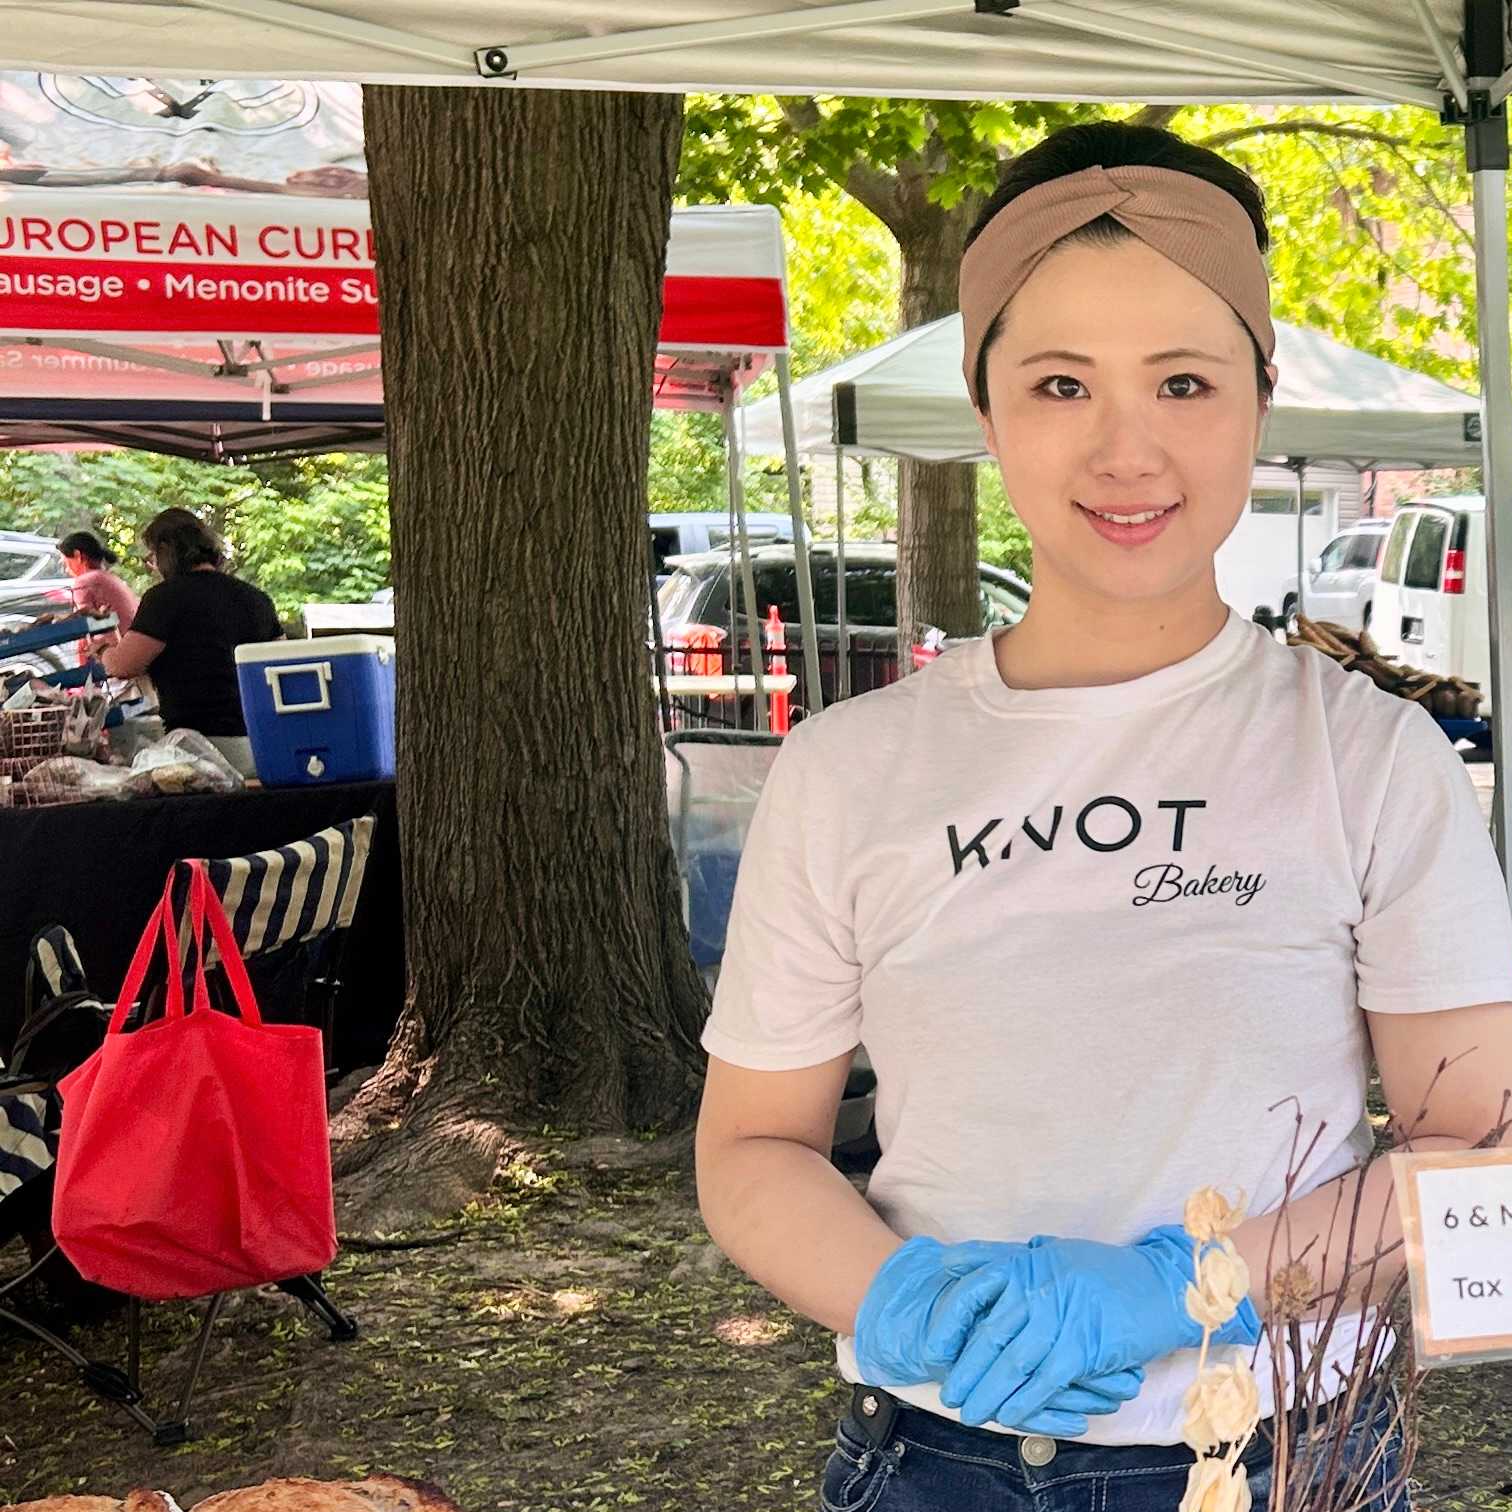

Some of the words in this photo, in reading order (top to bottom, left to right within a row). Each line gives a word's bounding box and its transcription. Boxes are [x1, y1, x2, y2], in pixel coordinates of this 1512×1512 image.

[164, 273, 331, 304] Menonite
[947, 796, 1207, 877] KNOT
[1133, 863, 1267, 907] Bakery
[1444, 1208, 1459, 1229] 6
[1469, 1206, 1489, 1227] &
[1453, 1277, 1503, 1299] Tax
